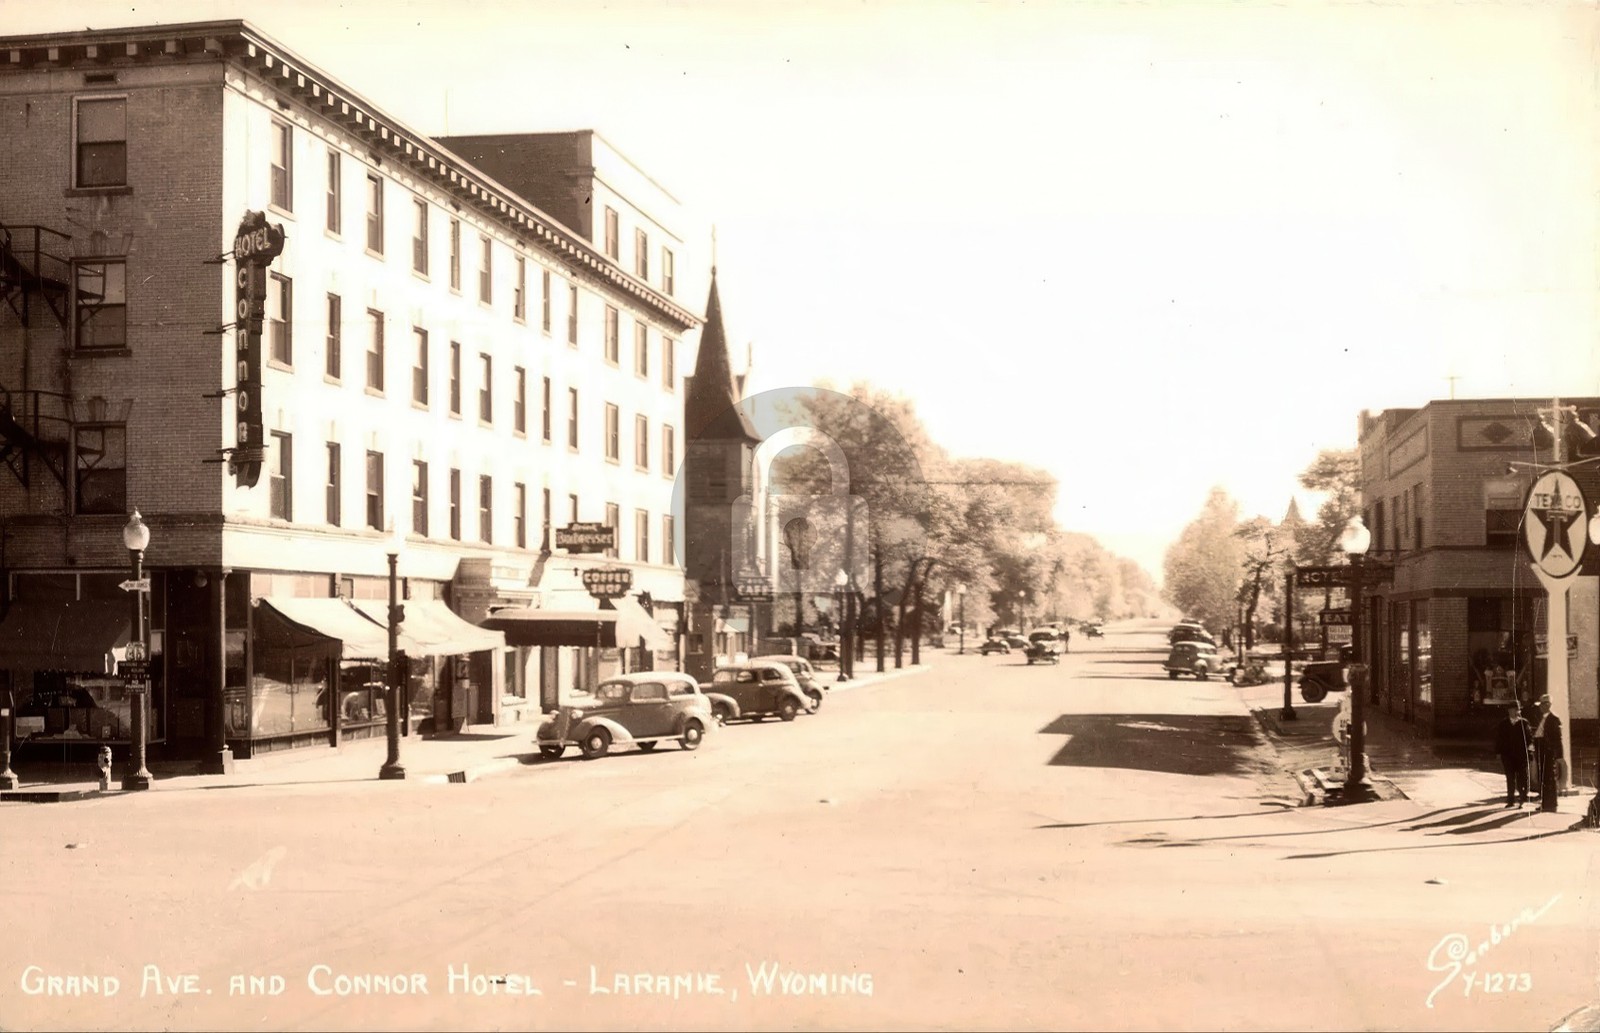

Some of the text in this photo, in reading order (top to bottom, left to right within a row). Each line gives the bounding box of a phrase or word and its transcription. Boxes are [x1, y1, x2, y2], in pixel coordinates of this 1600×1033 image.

[235, 226, 273, 259] HOTEL
[1535, 493, 1581, 509] TEXACO
[584, 572, 629, 583] COFFEE
[590, 583, 622, 594] SHOP
